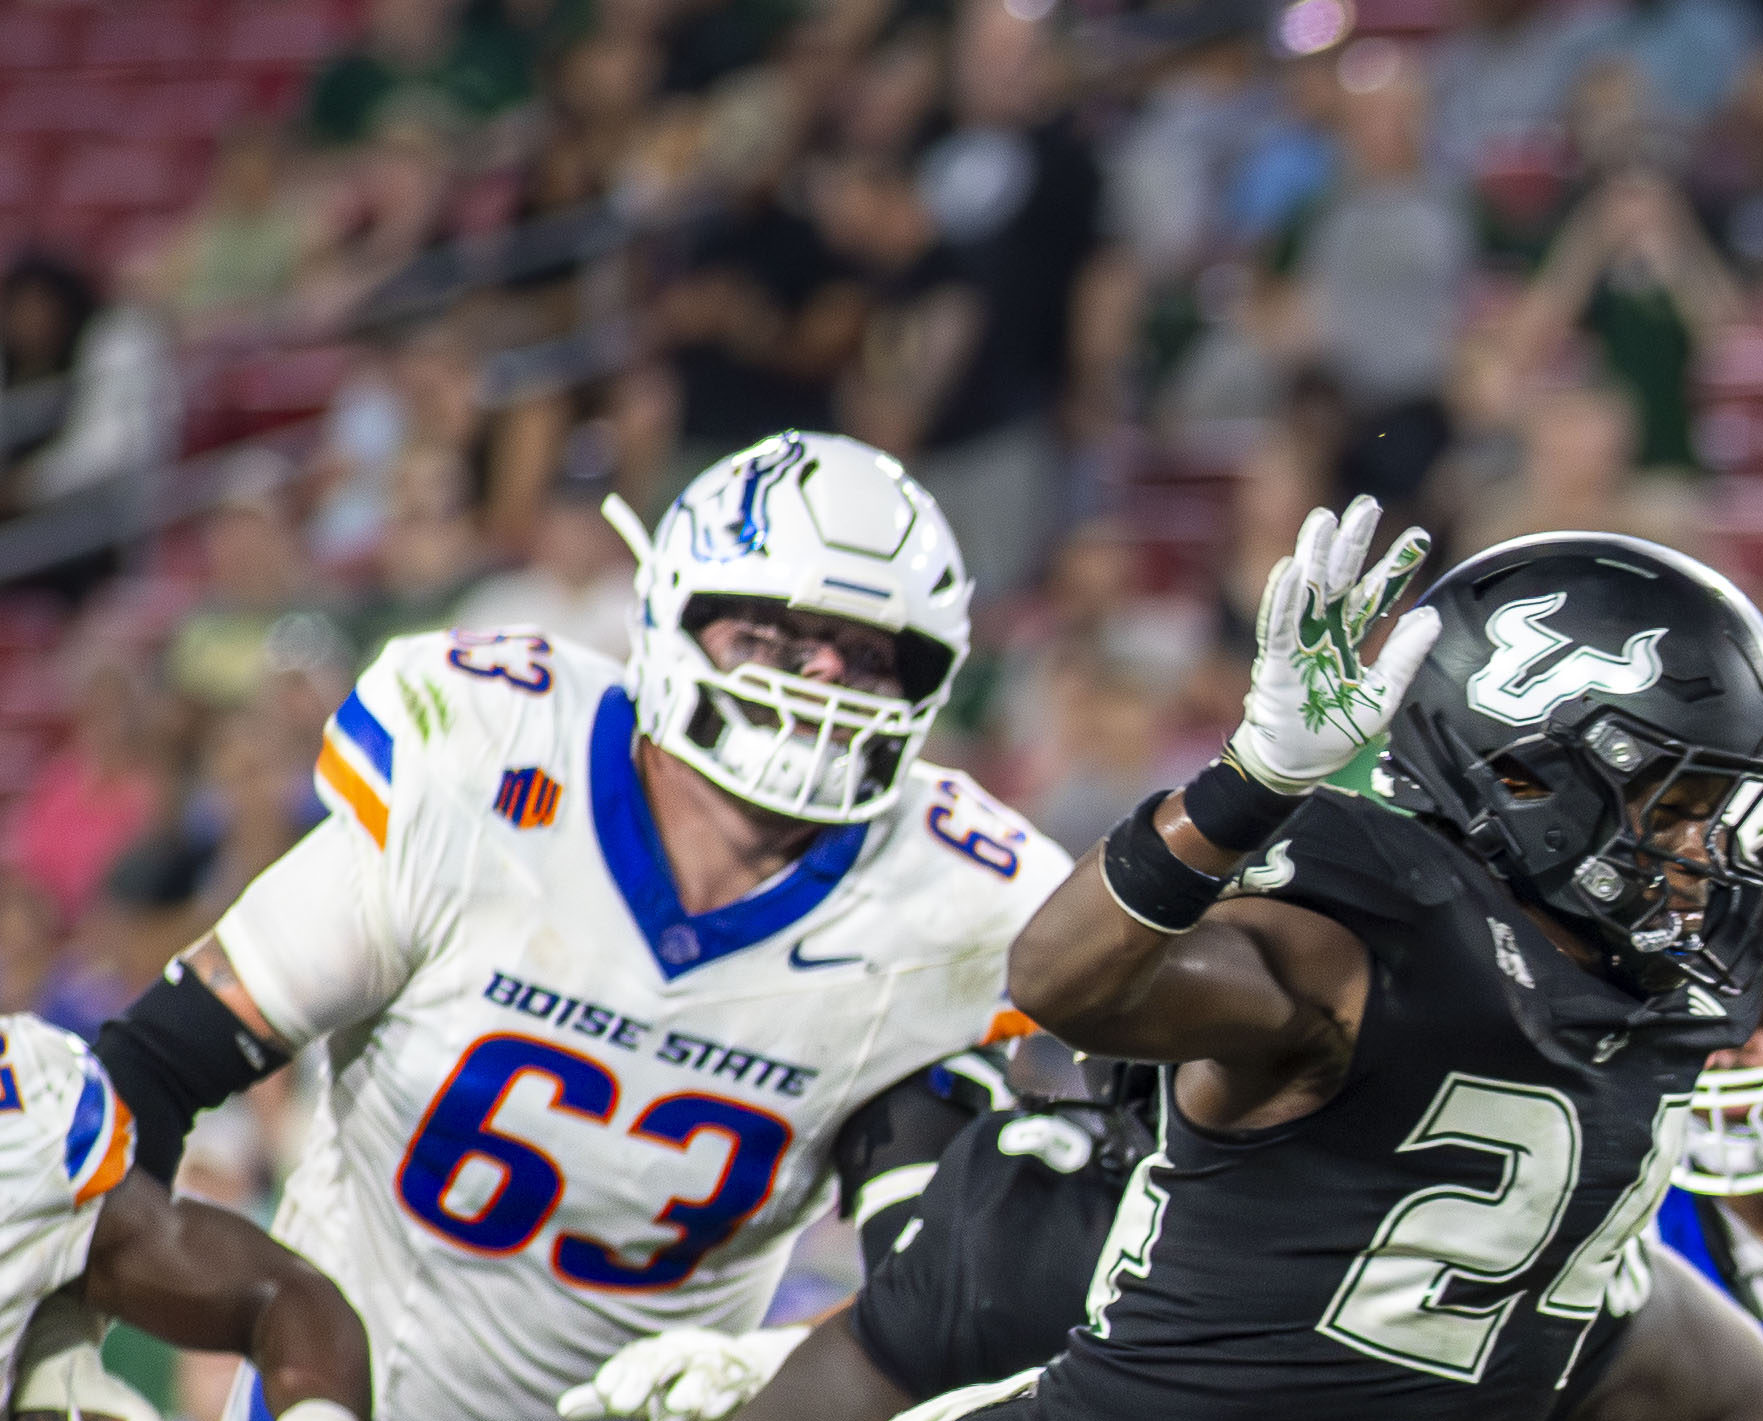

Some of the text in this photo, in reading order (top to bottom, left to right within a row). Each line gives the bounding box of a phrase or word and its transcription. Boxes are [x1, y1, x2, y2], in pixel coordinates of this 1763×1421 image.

[482, 969, 822, 1097] BOISE STATE
[395, 1031, 795, 1297] 63
